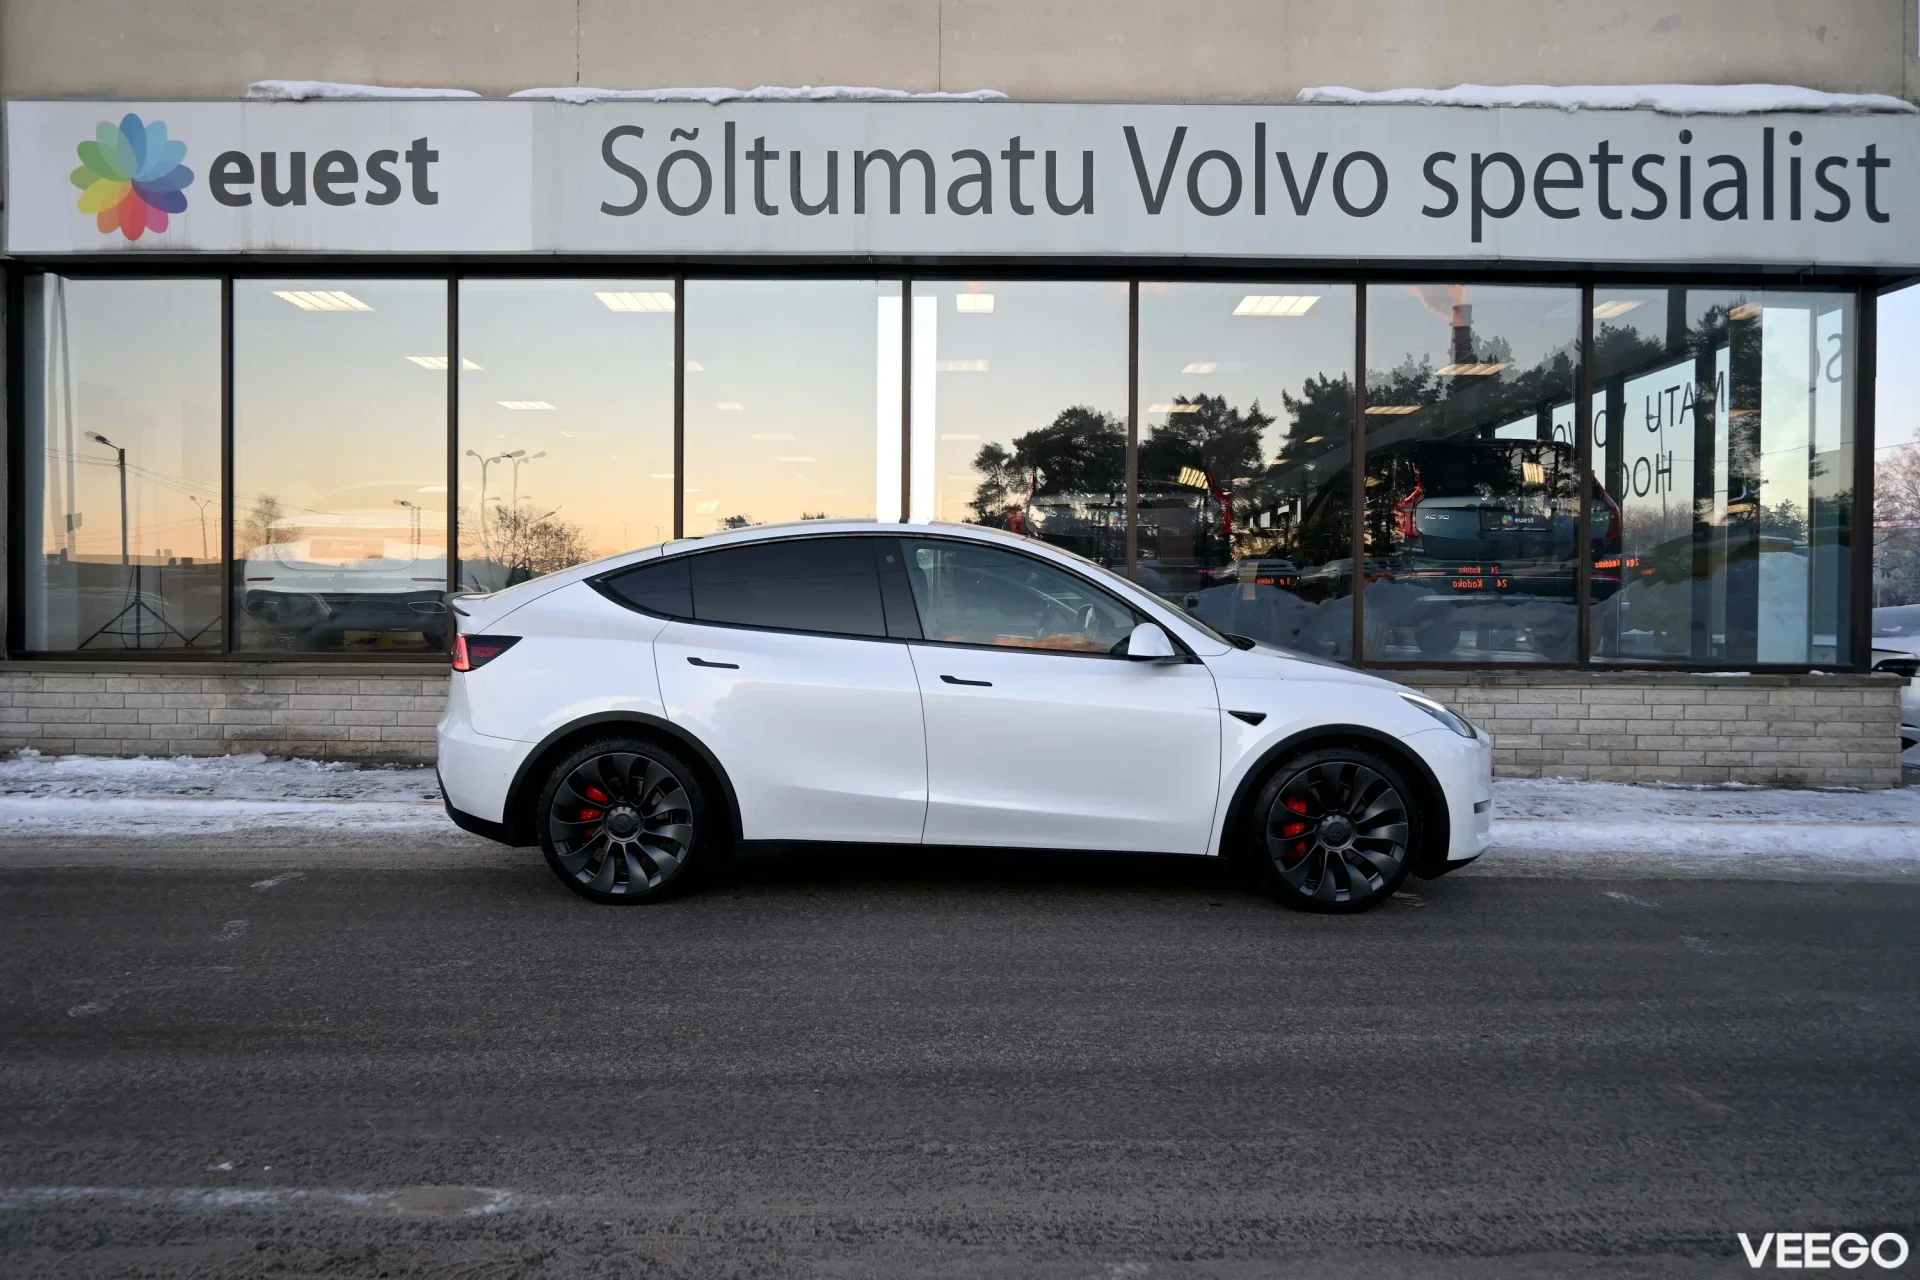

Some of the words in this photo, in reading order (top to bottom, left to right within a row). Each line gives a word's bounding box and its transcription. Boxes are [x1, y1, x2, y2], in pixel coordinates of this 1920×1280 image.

[208, 136, 439, 208] euest
[600, 121, 1094, 217] Sõltumatu
[1122, 121, 1389, 218] Volvo
[1421, 126, 1891, 244] spetsialist
